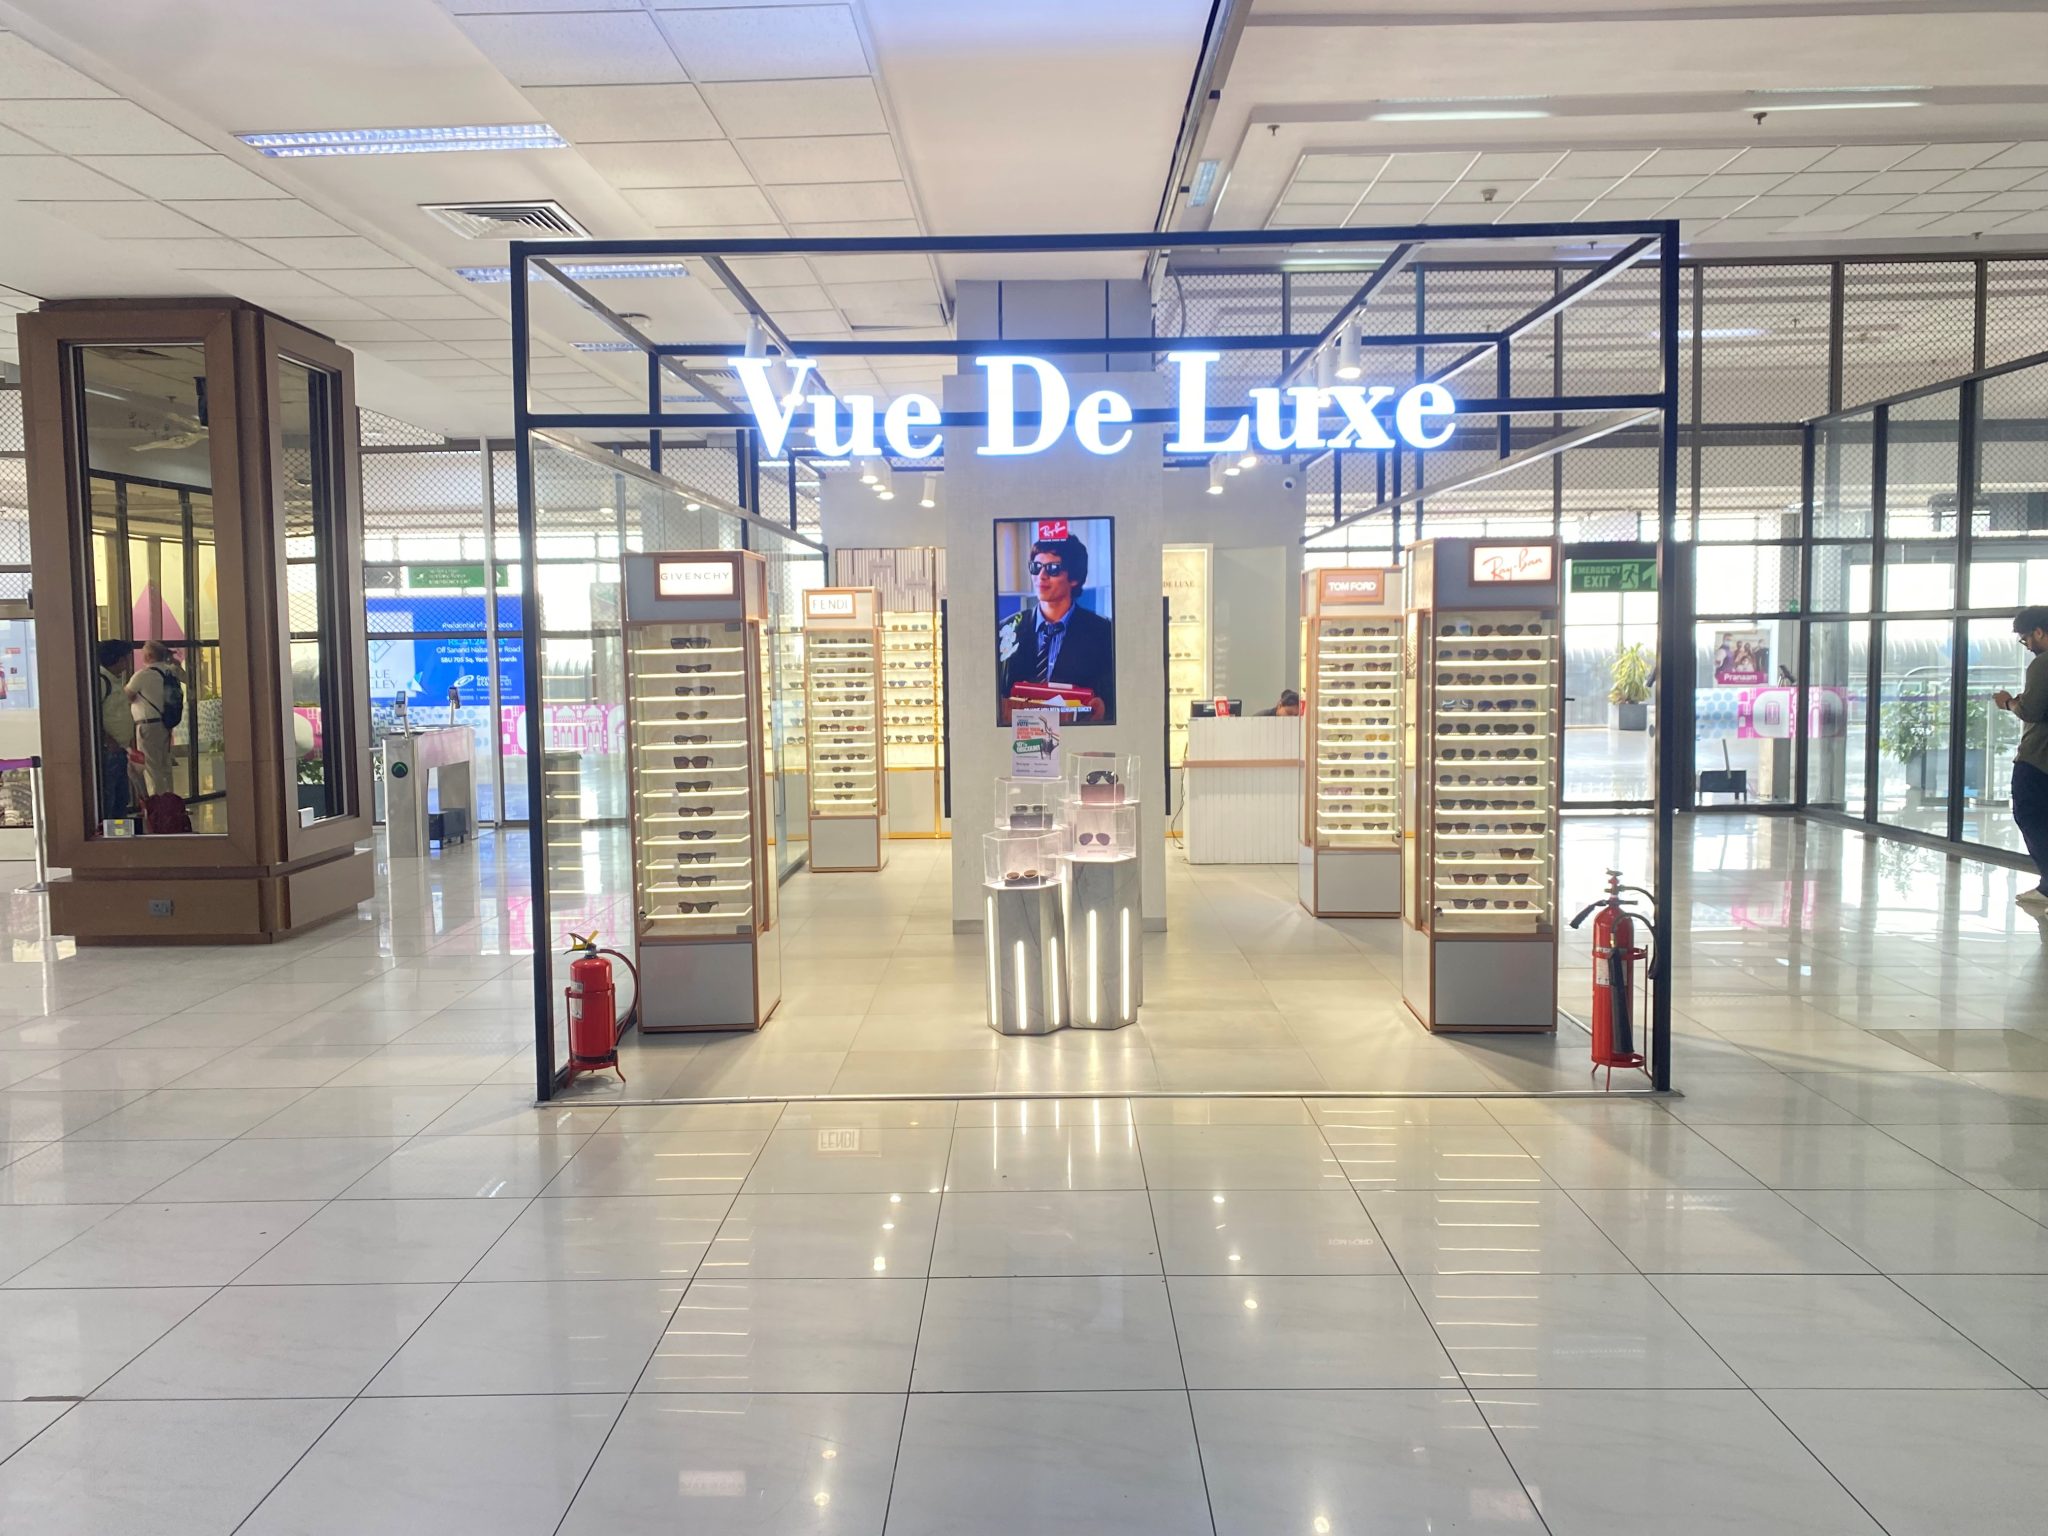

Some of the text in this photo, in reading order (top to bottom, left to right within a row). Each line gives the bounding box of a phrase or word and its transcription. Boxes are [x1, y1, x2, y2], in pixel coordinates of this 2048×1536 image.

[728, 352, 1456, 458] Vue De Luxe
[1573, 565, 1621, 575] EMERGENCY
[660, 572, 730, 581] GIVENCHY
[1583, 575, 1611, 588] EXIT
[1327, 581, 1377, 591] TOM FORD
[812, 600, 848, 610] FENDI
[504, 645, 521, 653] Road
[1723, 673, 1758, 681] Pranaam
